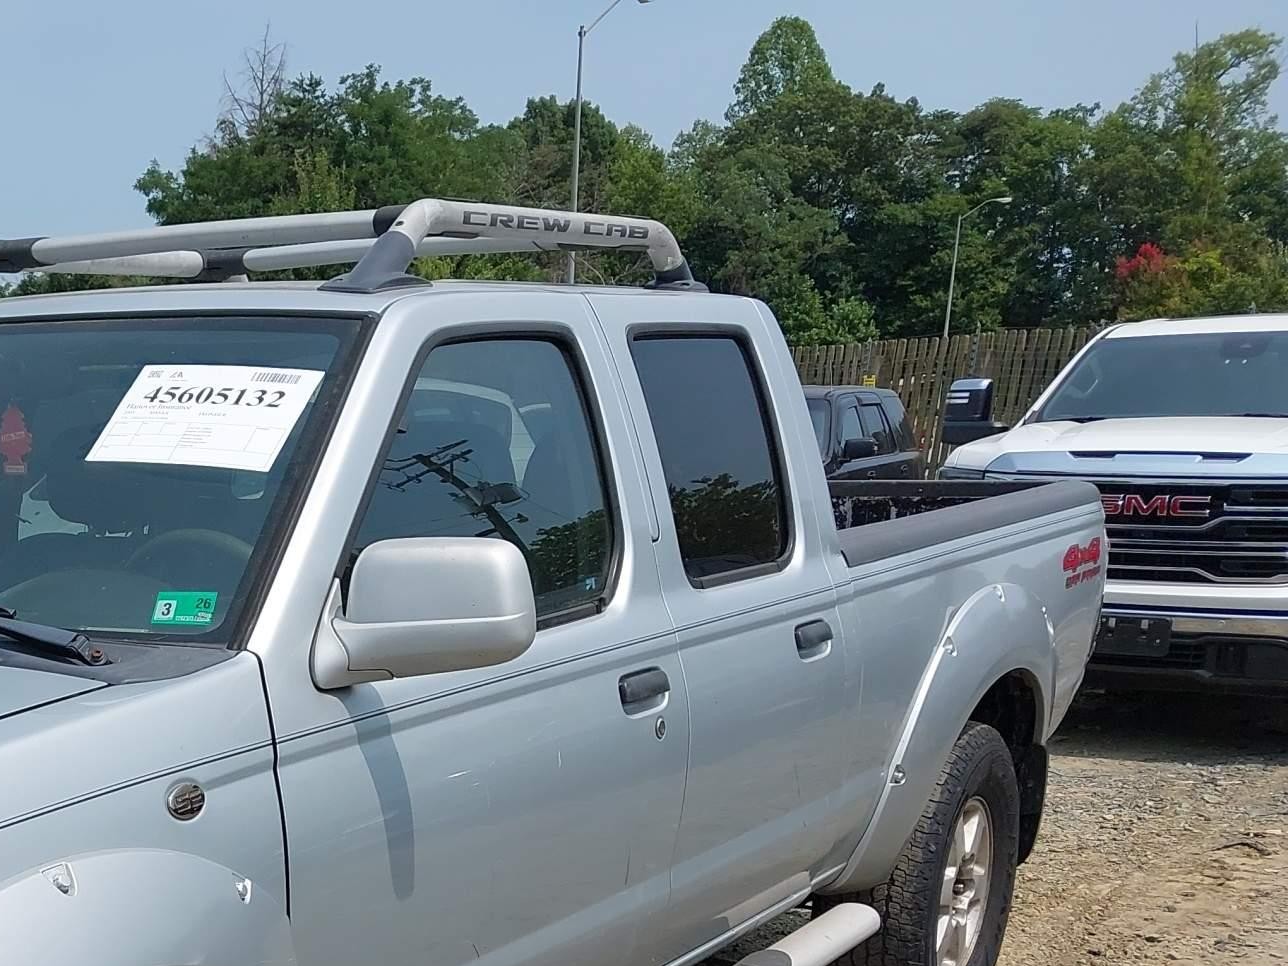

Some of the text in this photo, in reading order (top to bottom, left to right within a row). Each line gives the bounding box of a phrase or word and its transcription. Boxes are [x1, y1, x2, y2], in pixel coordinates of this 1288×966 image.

[463, 210, 649, 239] CREW CAB
[143, 385, 287, 408] 45605132
[162, 602, 172, 616] 3
[196, 598, 211, 609] 26
